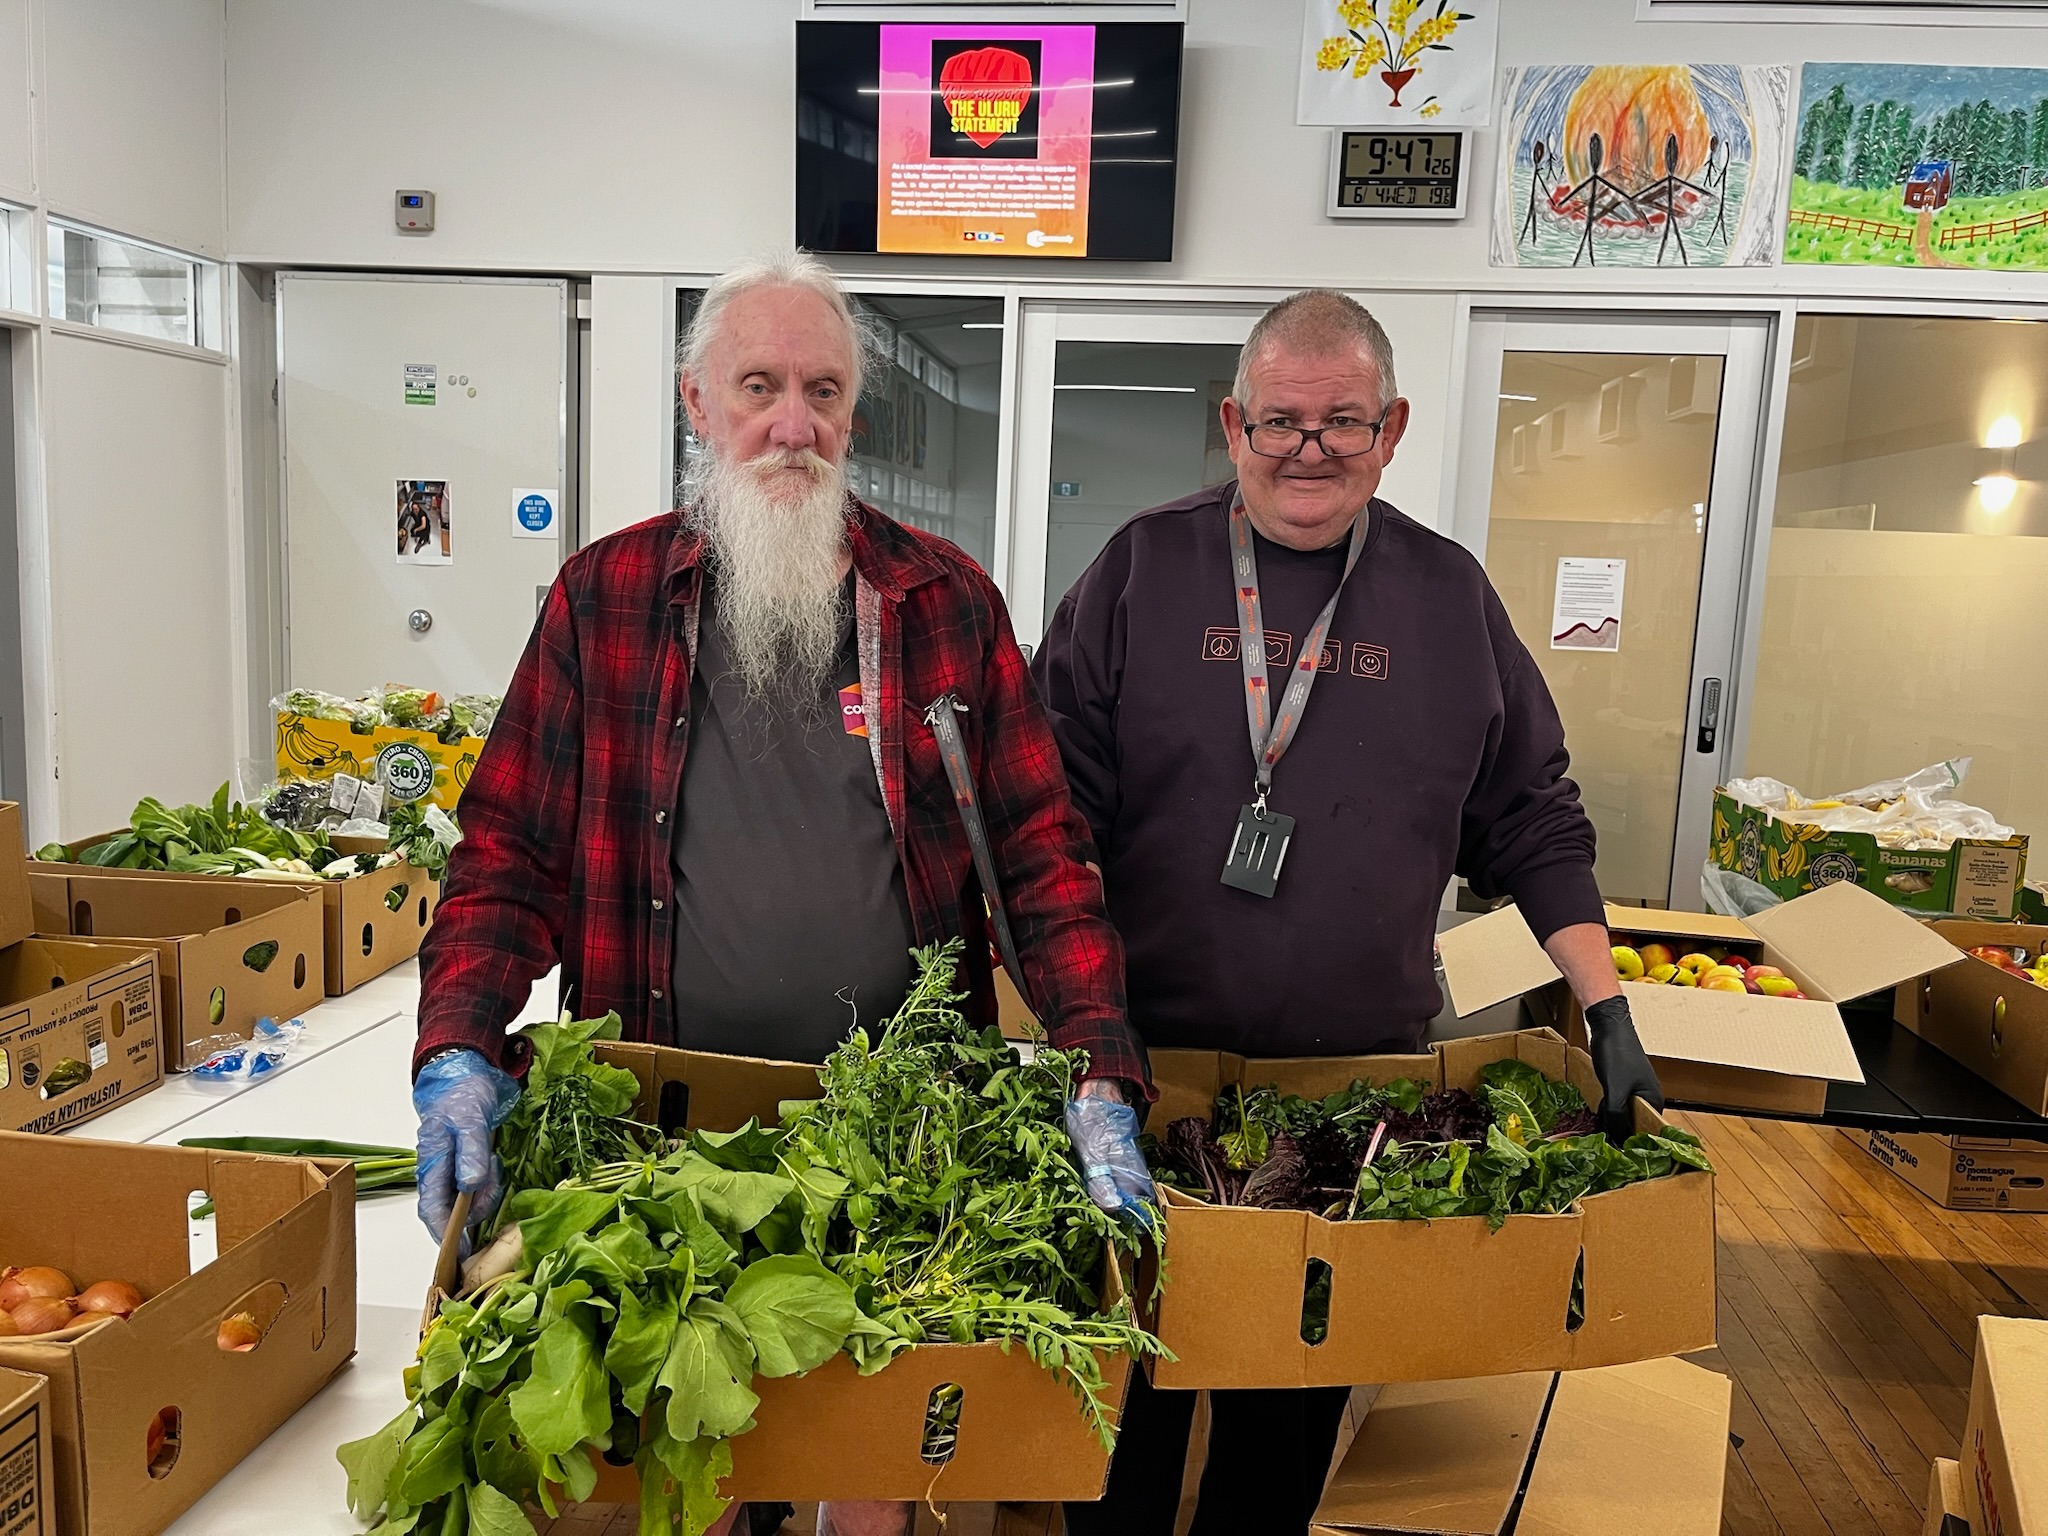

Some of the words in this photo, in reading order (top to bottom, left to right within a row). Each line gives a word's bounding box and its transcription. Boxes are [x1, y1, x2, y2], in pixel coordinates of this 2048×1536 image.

[971, 84, 1032, 102] support
[951, 100, 975, 117] THE
[978, 100, 1020, 117] ULURU
[951, 117, 1020, 133] STATEMENT
[1368, 138, 1433, 174] 9:47
[1431, 158, 1451, 175] 26
[407, 746, 431, 771] CHOICE
[390, 764, 420, 779] 360
[1878, 851, 1947, 868] Bananas
[1821, 869, 1845, 879] 360
[69, 1003, 99, 1021] PRODUCT
[128, 1001, 148, 1017] DBM
[58, 1015, 68, 1024] OF
[19, 1022, 57, 1042] AUSTRALIA
[59, 1079, 122, 1118] AUSTRALIAN
[1868, 1137, 1895, 1167] farms
[1871, 1130, 1919, 1169] montague
[1966, 1167, 2016, 1177] montague
[1966, 1173, 1993, 1182] farms
